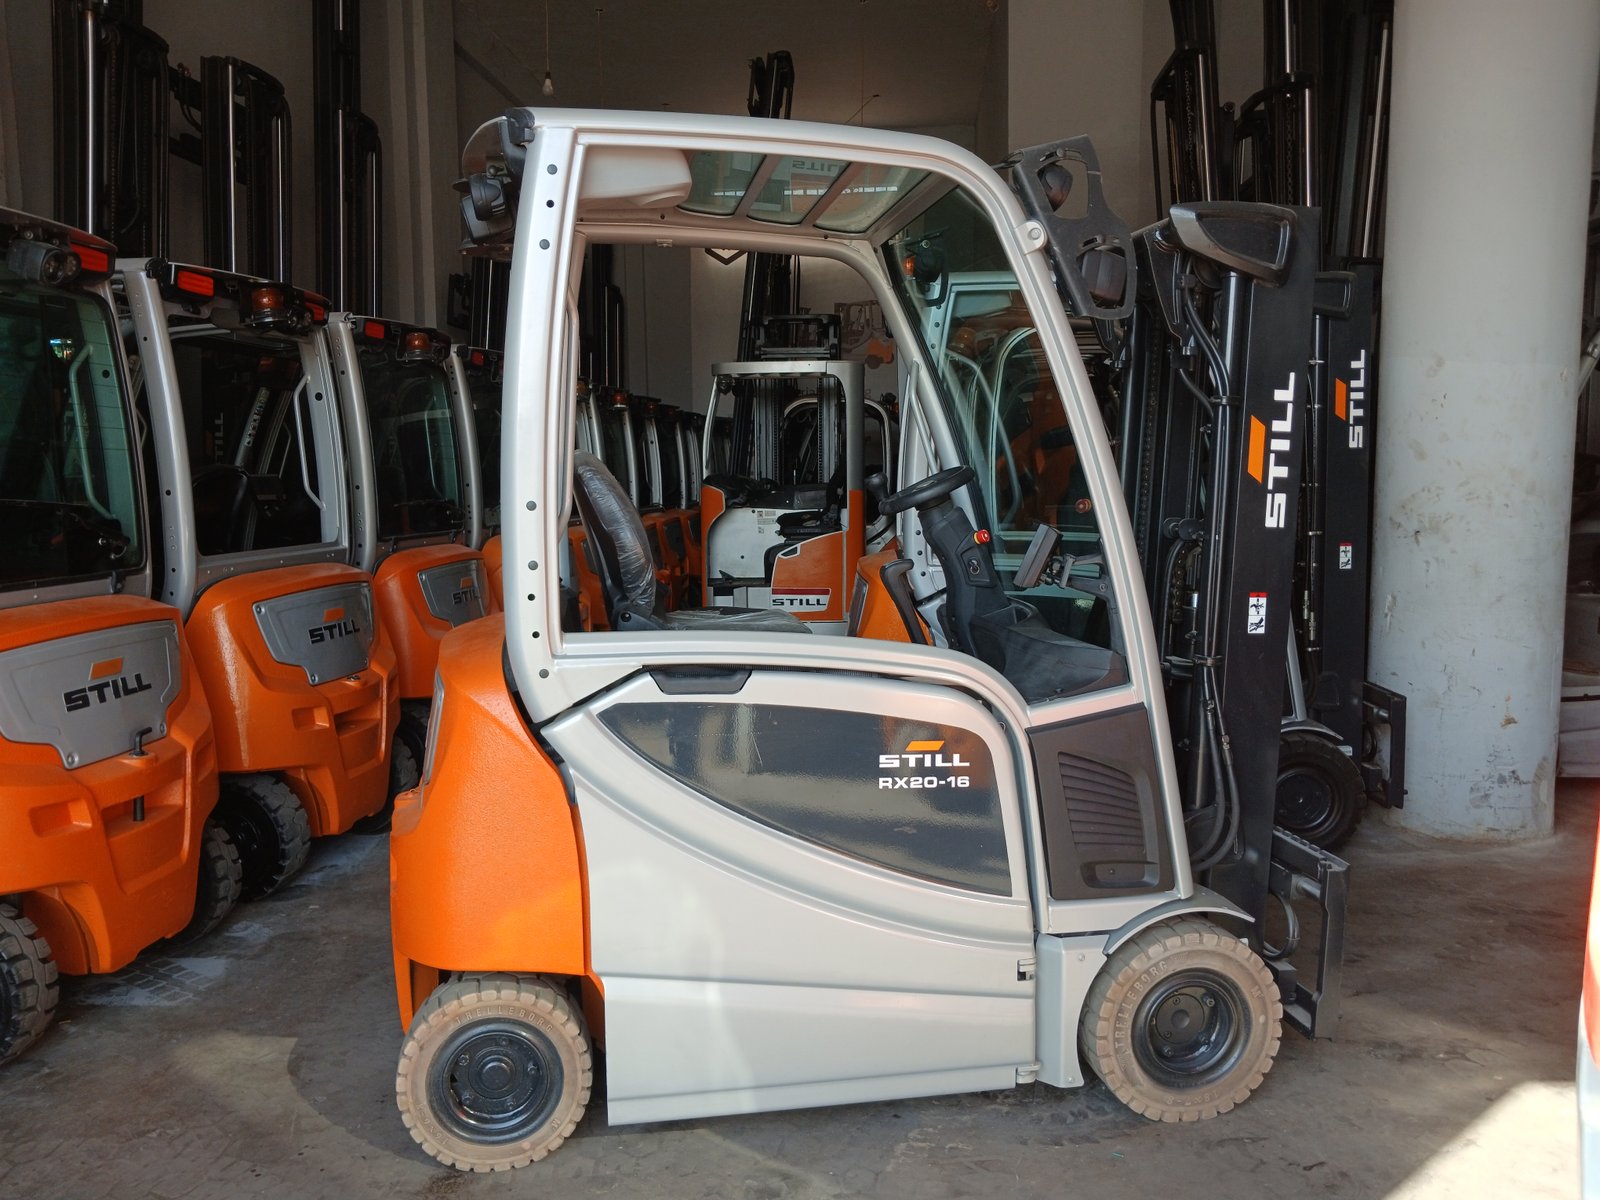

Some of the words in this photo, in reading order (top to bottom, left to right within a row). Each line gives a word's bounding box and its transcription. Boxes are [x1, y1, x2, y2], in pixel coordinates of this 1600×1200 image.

[1348, 349, 1365, 448] STILL
[214, 412, 224, 462] TILL
[1264, 371, 1296, 529] STILL
[772, 598, 827, 606] STILL
[308, 618, 360, 645] STILL
[63, 672, 152, 713] STILL
[879, 753, 970, 768] STILL
[878, 776, 970, 789] RX20-16
[455, 1004, 553, 1033] TRELLEBORG
[1114, 960, 1169, 1050] TRELLEBORG
